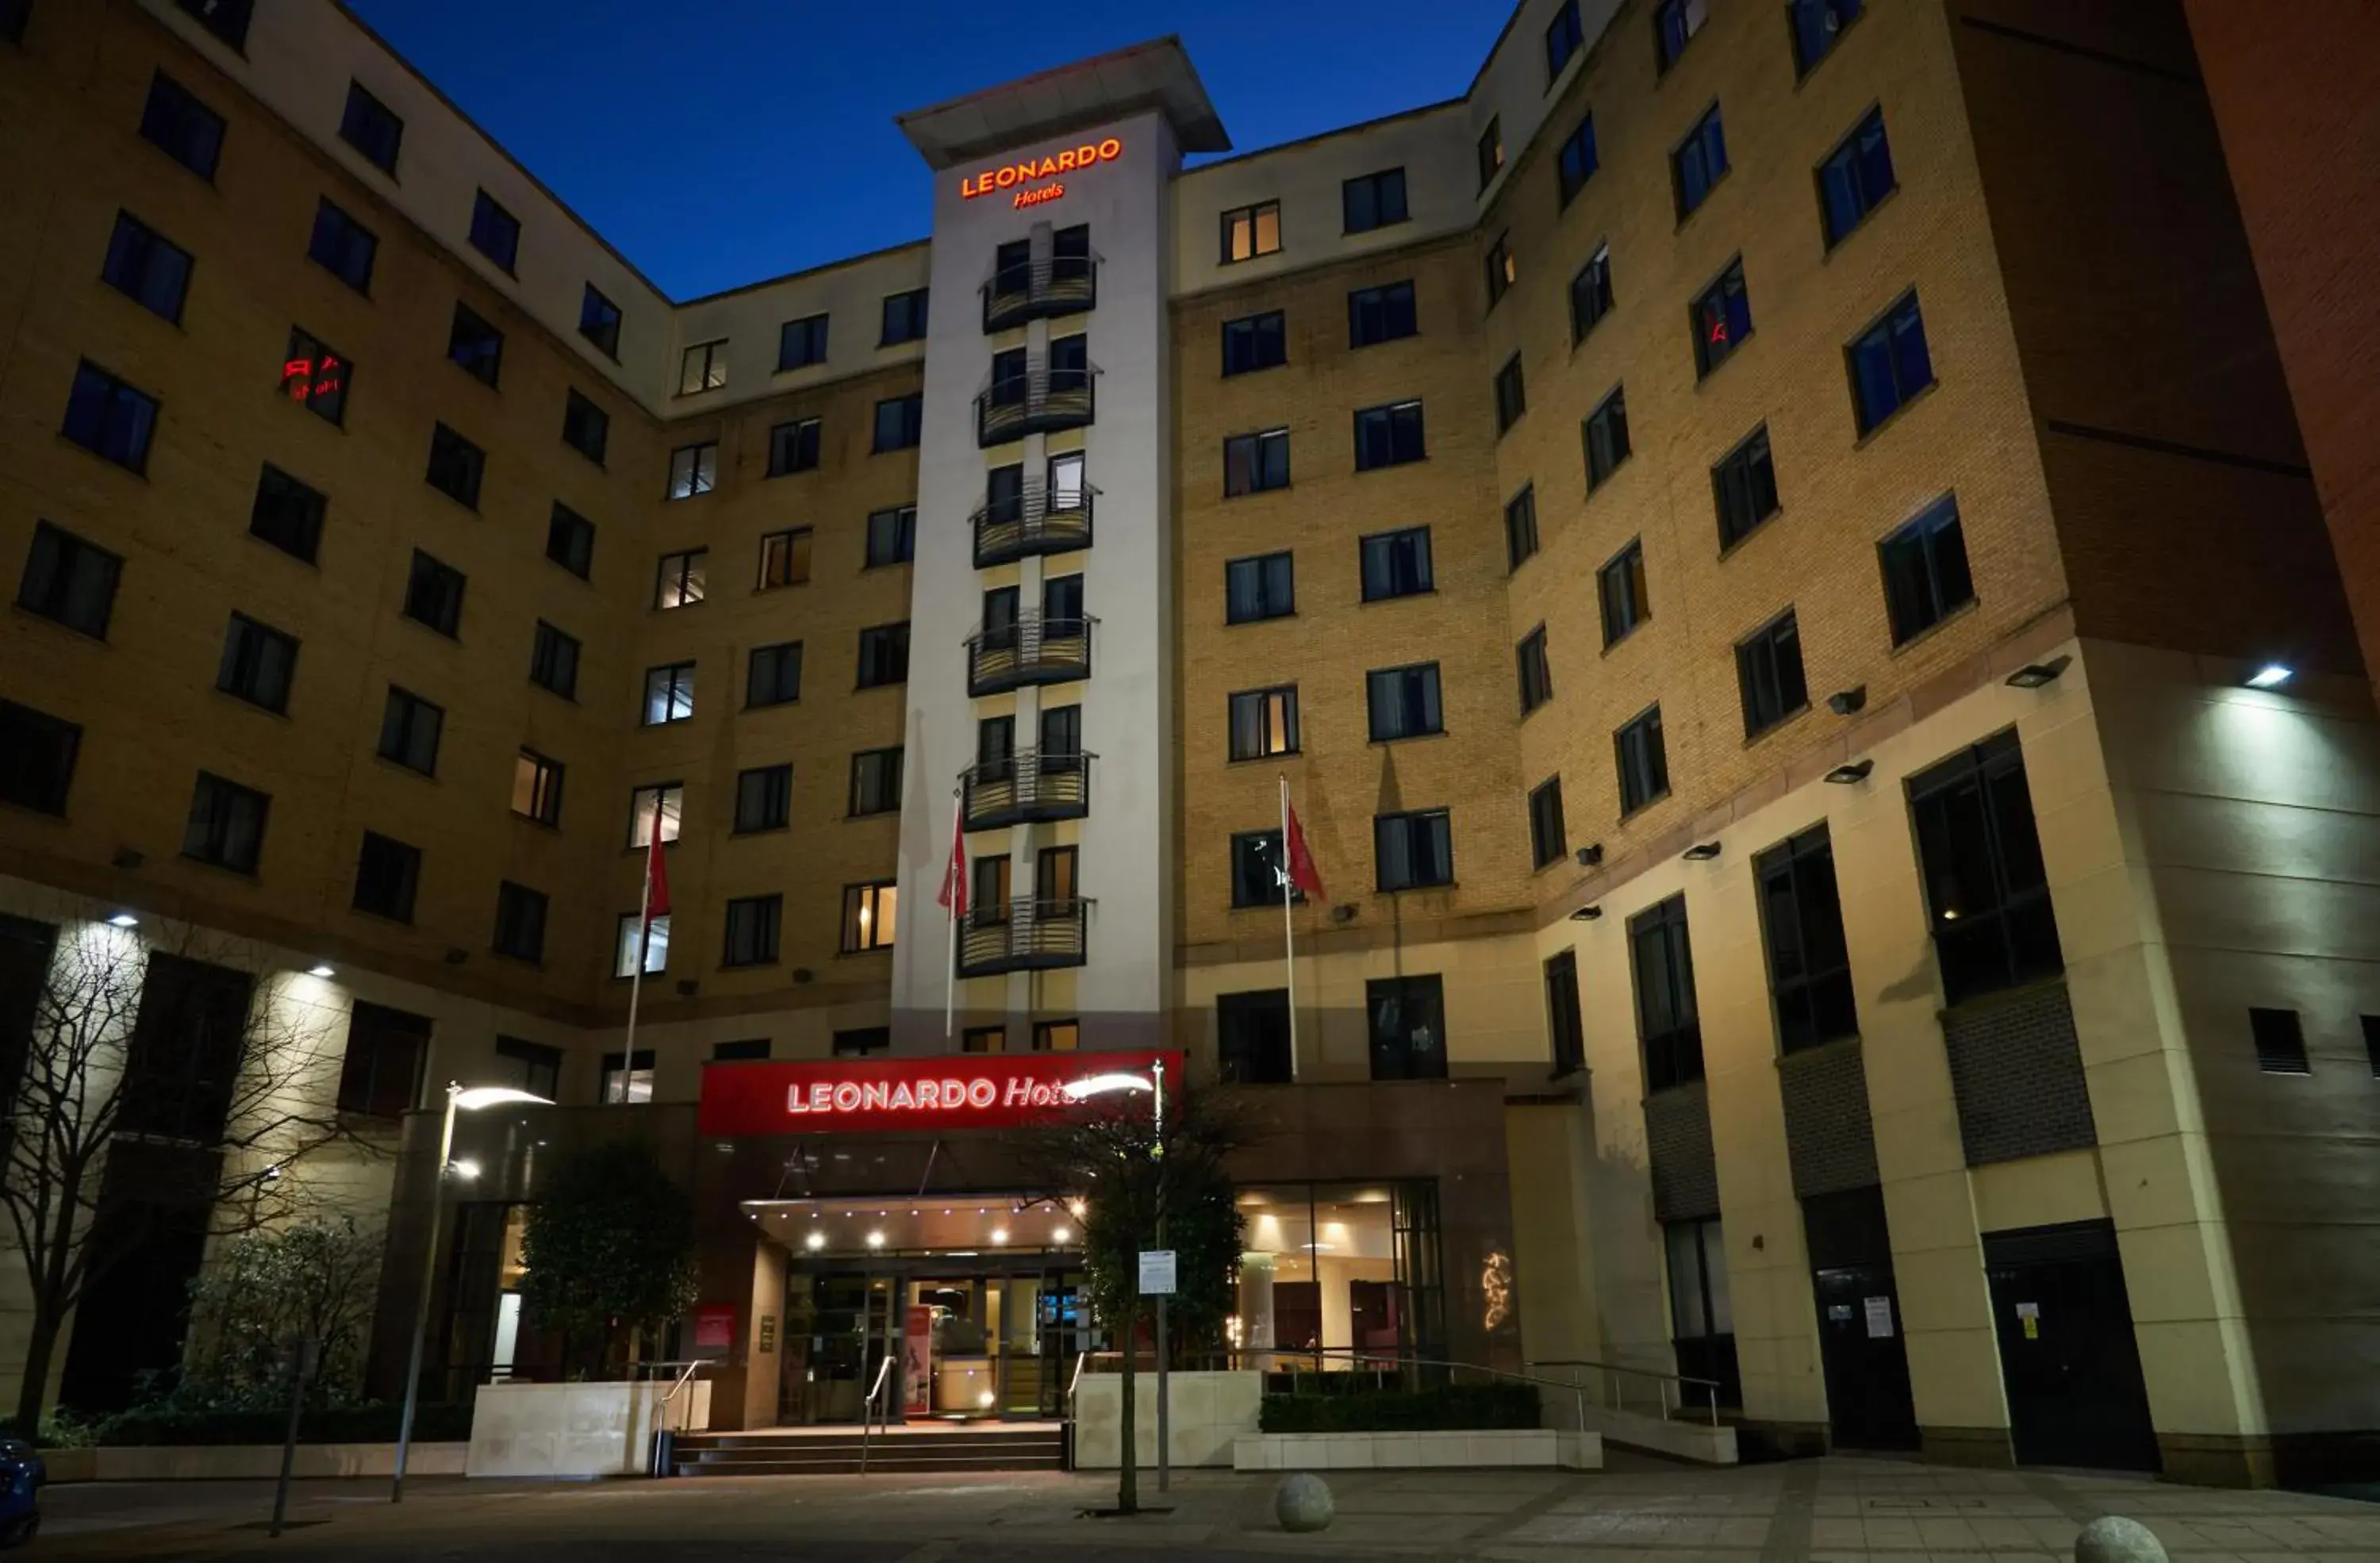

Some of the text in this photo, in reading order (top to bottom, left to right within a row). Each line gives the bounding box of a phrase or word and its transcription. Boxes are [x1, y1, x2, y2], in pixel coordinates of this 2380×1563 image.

[962, 138, 1121, 198] LEONARDO
[1013, 182, 1065, 209] Hotels
[788, 1078, 996, 1113] LEONARDO
